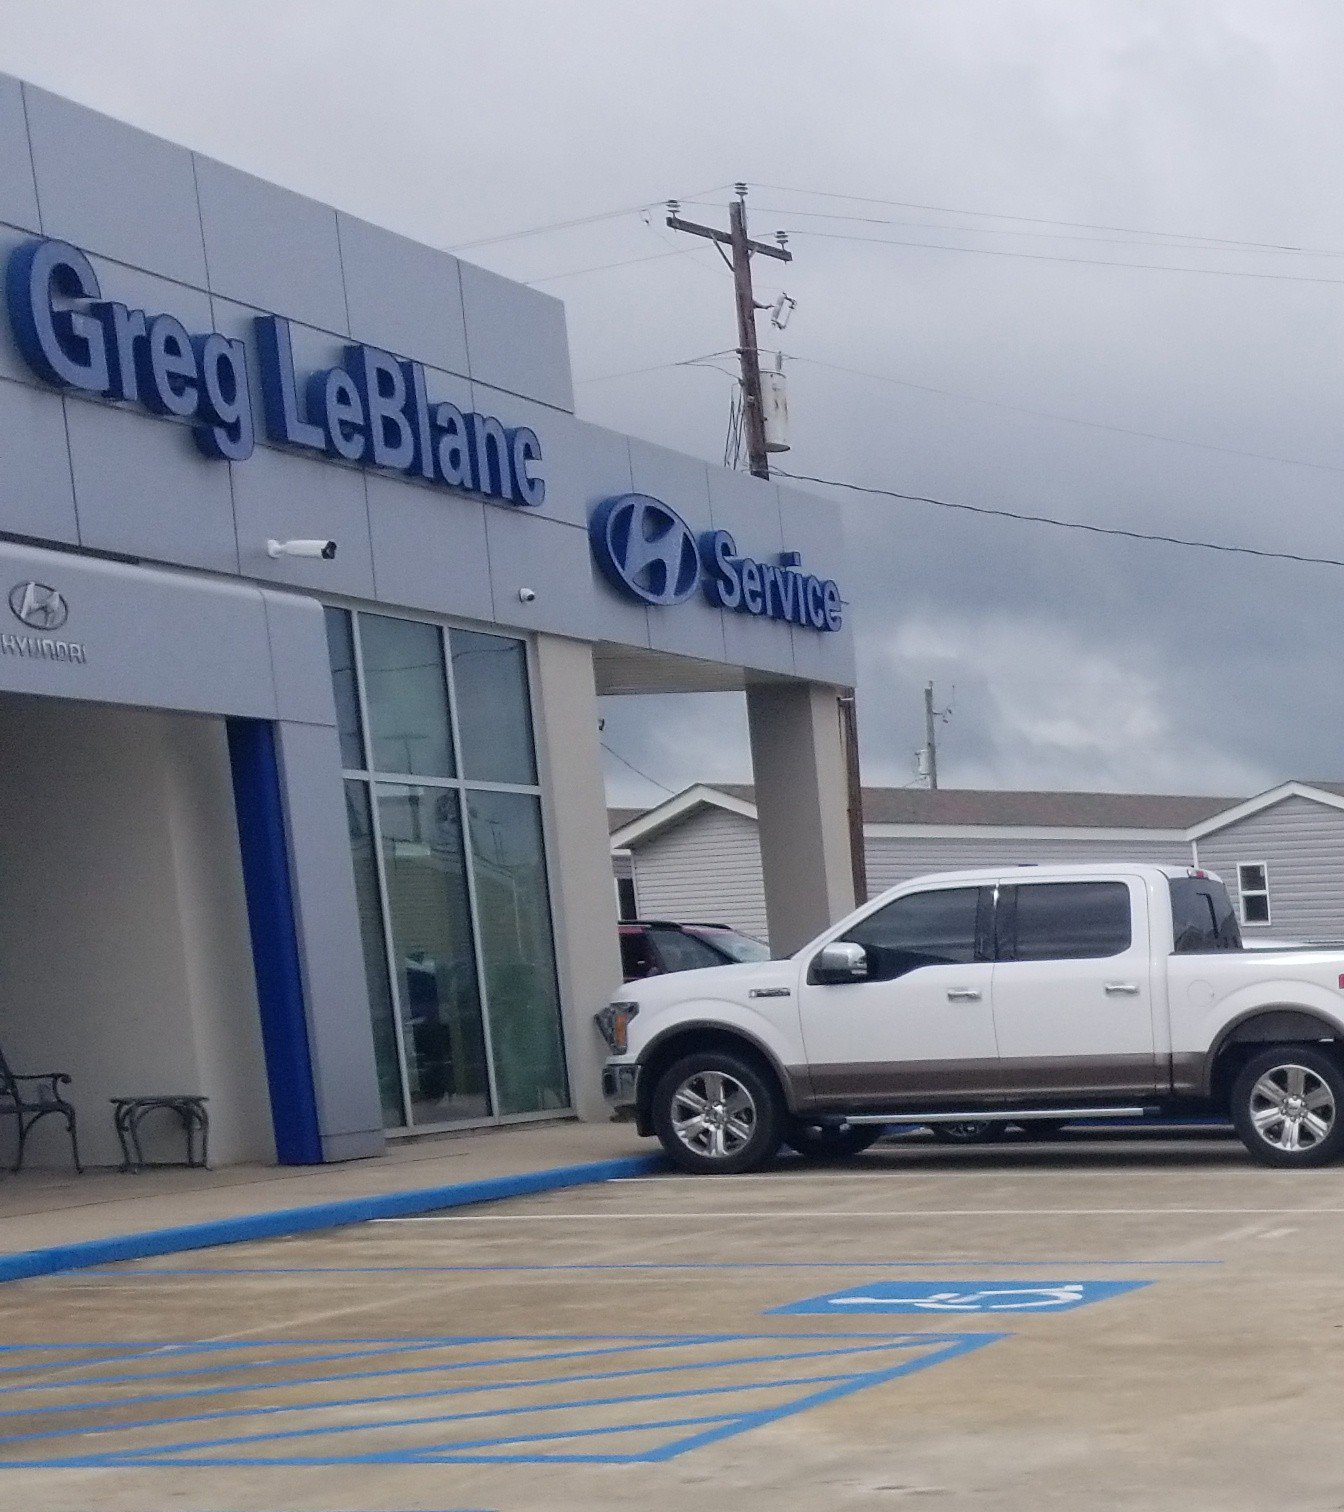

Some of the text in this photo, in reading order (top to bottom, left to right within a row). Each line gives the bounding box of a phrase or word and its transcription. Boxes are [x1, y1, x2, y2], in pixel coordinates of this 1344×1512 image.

[6, 238, 546, 507] Greg LeBlanc
[701, 529, 843, 632] Service
[1, 634, 87, 664] HYUNDAI
